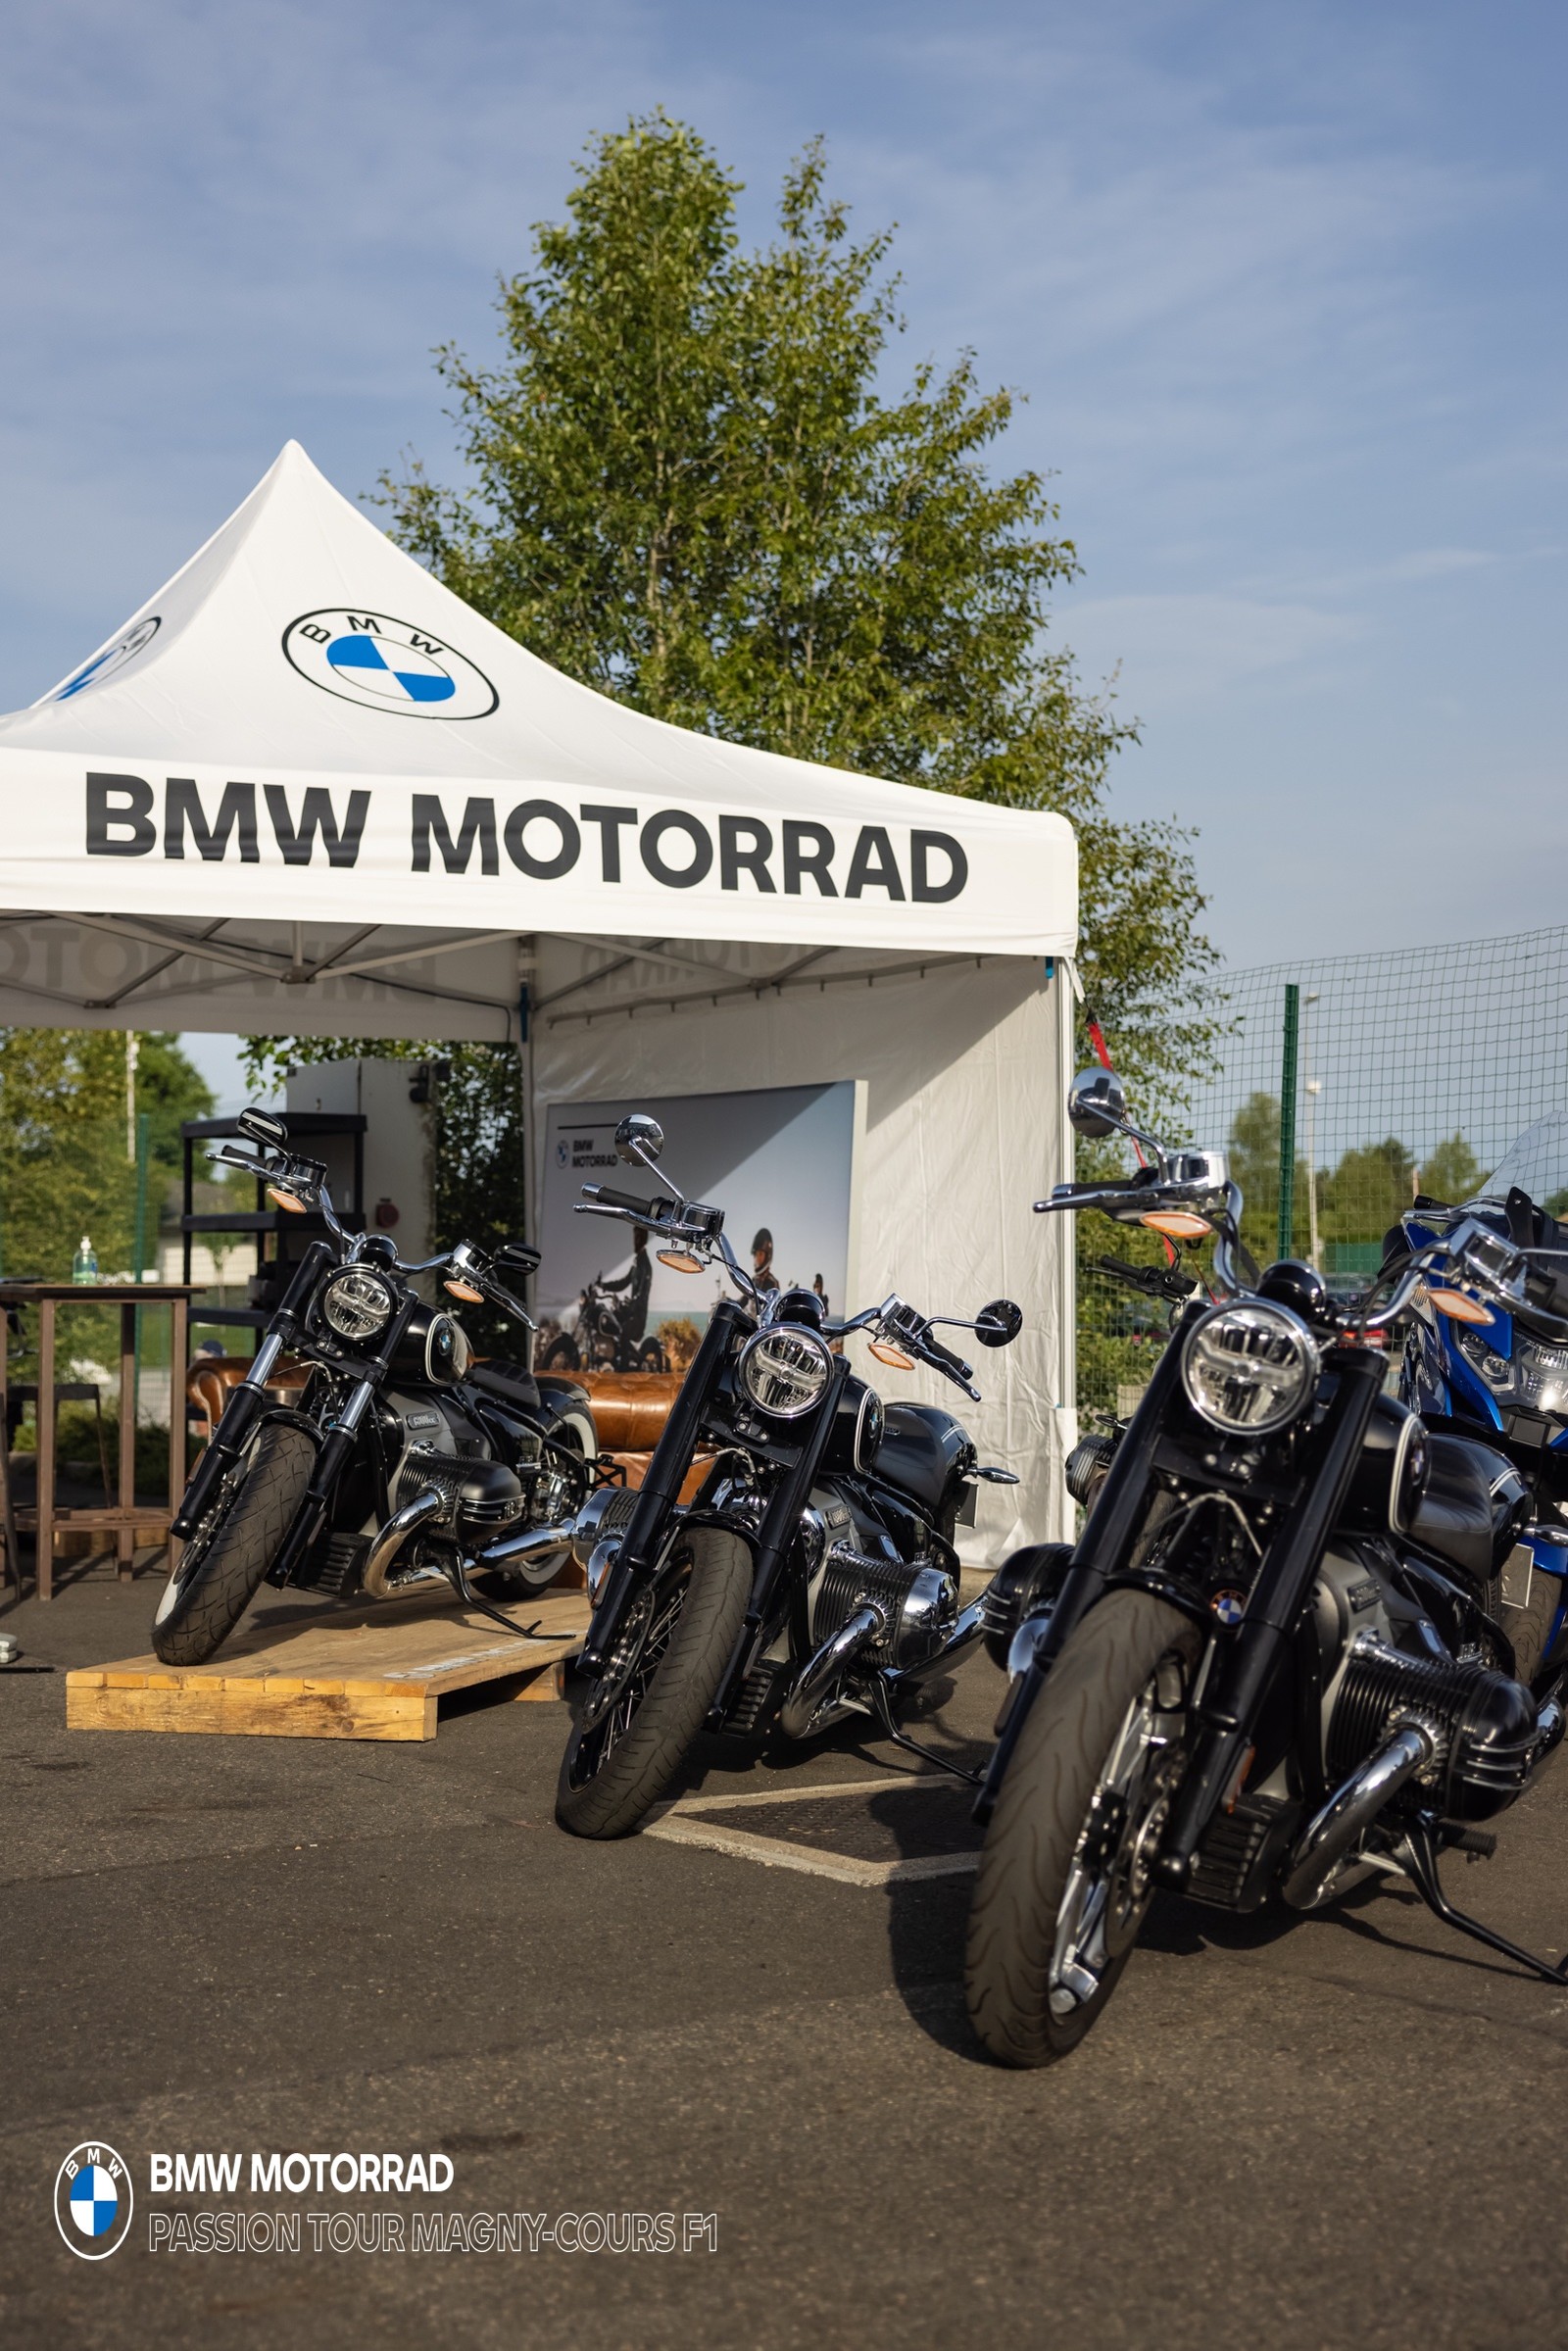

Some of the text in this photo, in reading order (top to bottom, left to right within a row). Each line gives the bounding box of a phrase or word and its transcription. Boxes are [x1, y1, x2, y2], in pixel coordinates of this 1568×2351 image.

[300, 616, 443, 655] BMW
[86, 772, 968, 904] BMW MOTORRAD
[573, 1140, 594, 1152] BMW
[572, 1154, 617, 1168] MOTORRAD
